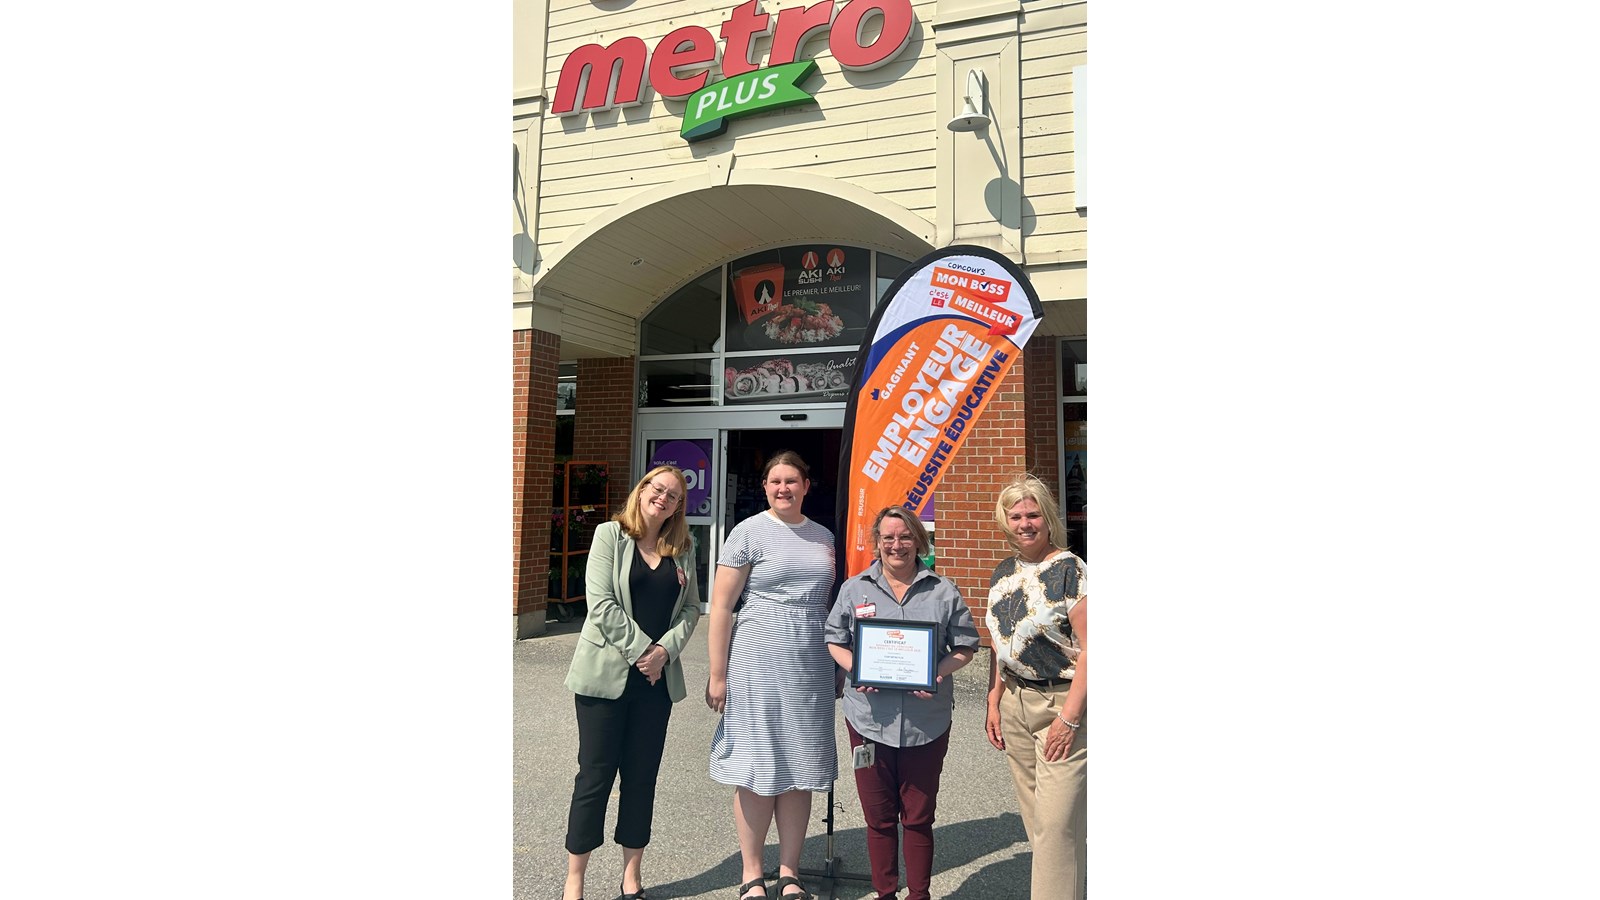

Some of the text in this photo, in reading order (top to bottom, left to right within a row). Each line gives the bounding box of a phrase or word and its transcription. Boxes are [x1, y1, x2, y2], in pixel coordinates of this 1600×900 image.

[551, 0, 914, 116] metro
[694, 73, 780, 120] PLUS
[798, 269, 823, 279] AKI
[826, 266, 846, 275] AKI
[947, 262, 986, 276] concours
[929, 289, 949, 299] c'est
[936, 273, 1006, 296] MON BOSS
[750, 306, 767, 317] AKI
[954, 295, 1016, 328] MEILLEUR
[826, 357, 857, 371] Qualit
[880, 341, 920, 400] GAGNANT
[861, 324, 968, 483] EMPLOYEUR
[902, 349, 1009, 511] RÉUSSITE ÉDUCATIVE
